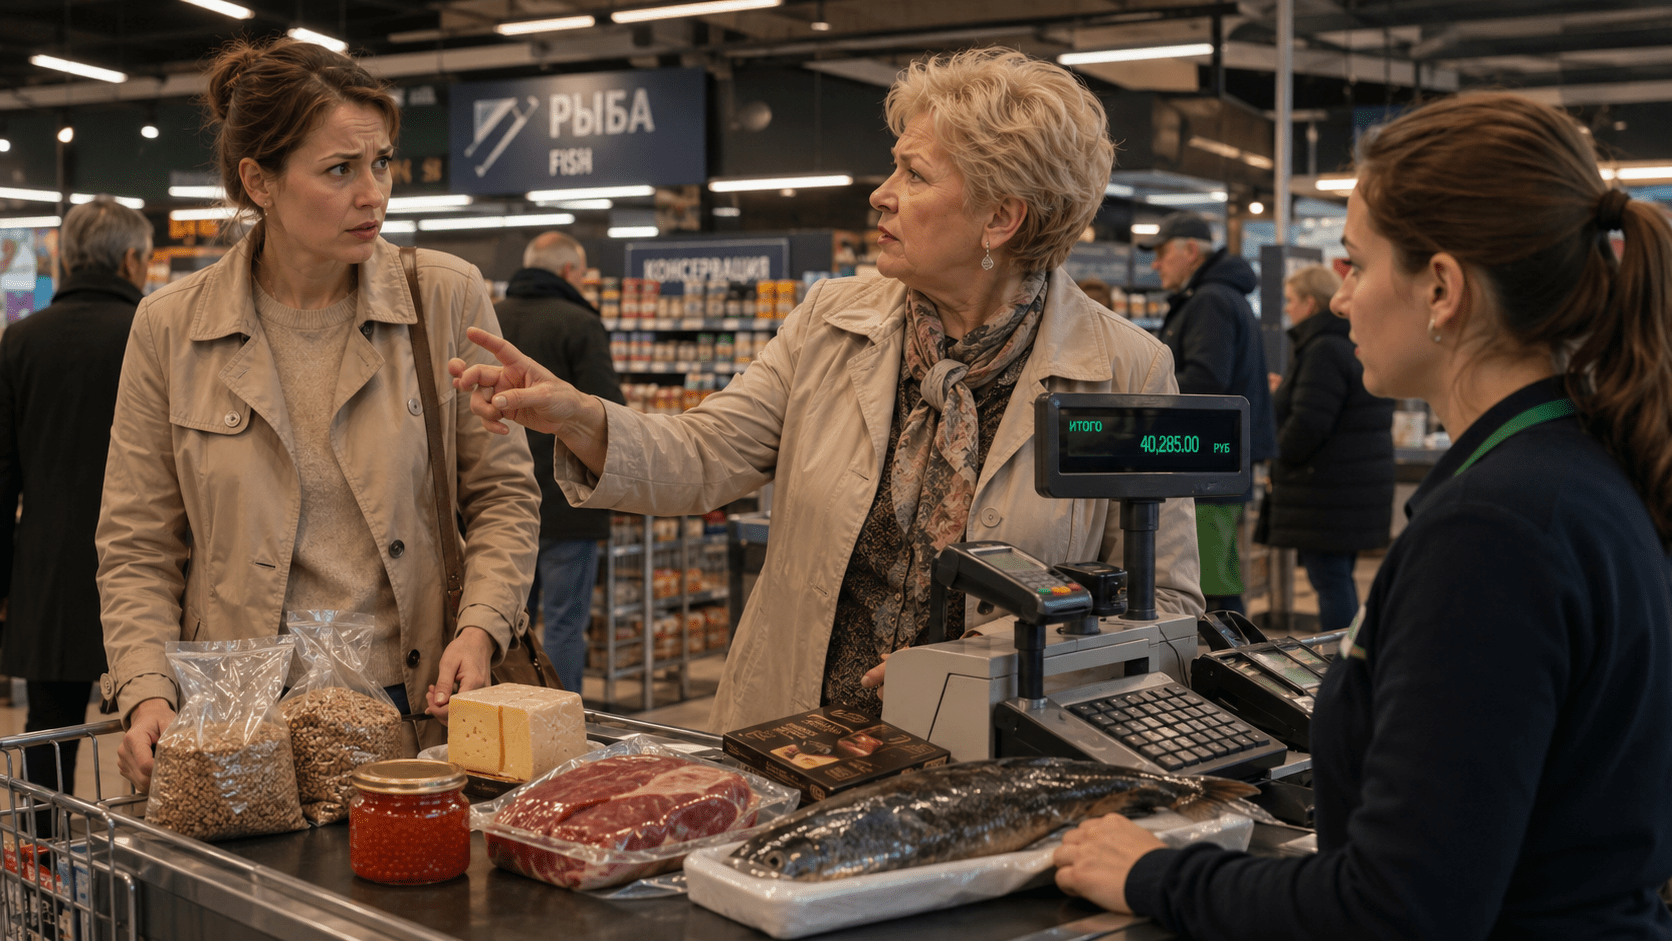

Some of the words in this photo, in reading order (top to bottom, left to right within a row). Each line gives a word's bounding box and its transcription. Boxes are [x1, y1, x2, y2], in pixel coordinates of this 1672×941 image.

[549, 88, 655, 138] РЫБА
[549, 147, 593, 176] FISH
[643, 255, 770, 284] КОНСЕРВАЦИЯ
[1069, 420, 1102, 432] ИТОГО
[1140, 435, 1199, 455] 40,285.00
[1213, 443, 1230, 453] РУБ
